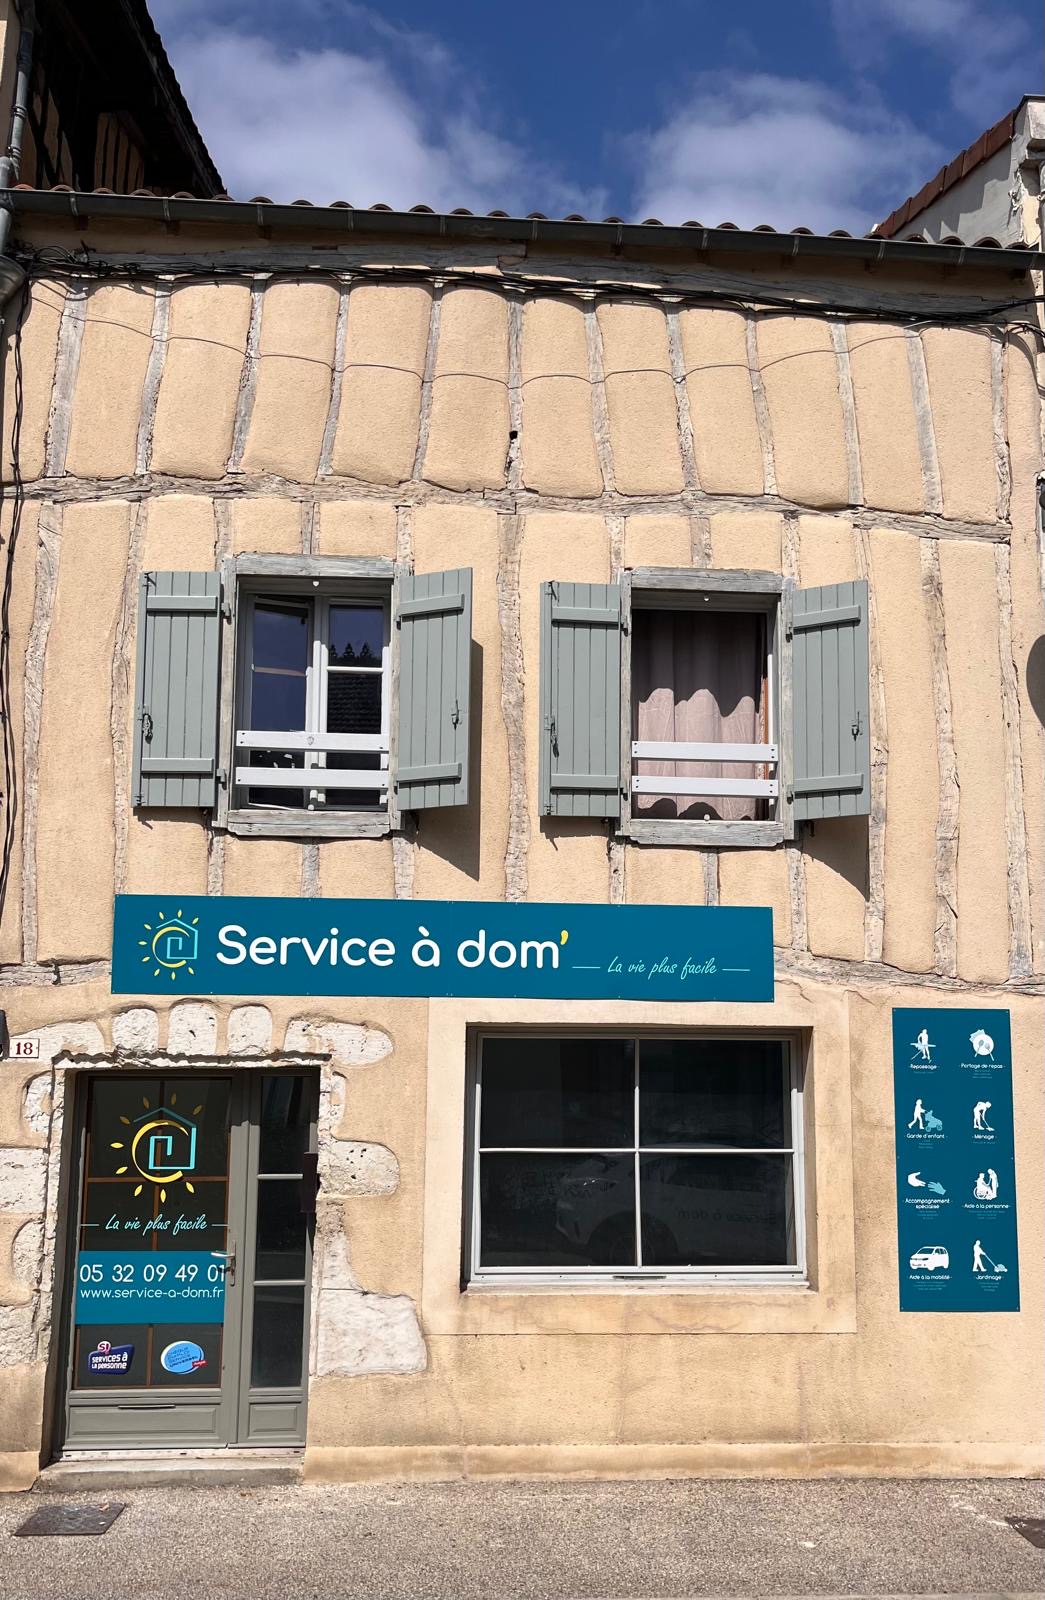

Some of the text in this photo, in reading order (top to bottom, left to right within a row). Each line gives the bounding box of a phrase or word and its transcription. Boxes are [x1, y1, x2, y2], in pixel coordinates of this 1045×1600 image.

[216, 924, 569, 969] Service à dom'
[607, 956, 718, 980] La vie plus facile
[16, 1042, 33, 1055] 18
[105, 1213, 208, 1236] La vie plus facile
[79, 1264, 225, 1283] 05 32 09 49 01
[80, 1286, 224, 1299] www.service-a-dom.fr
